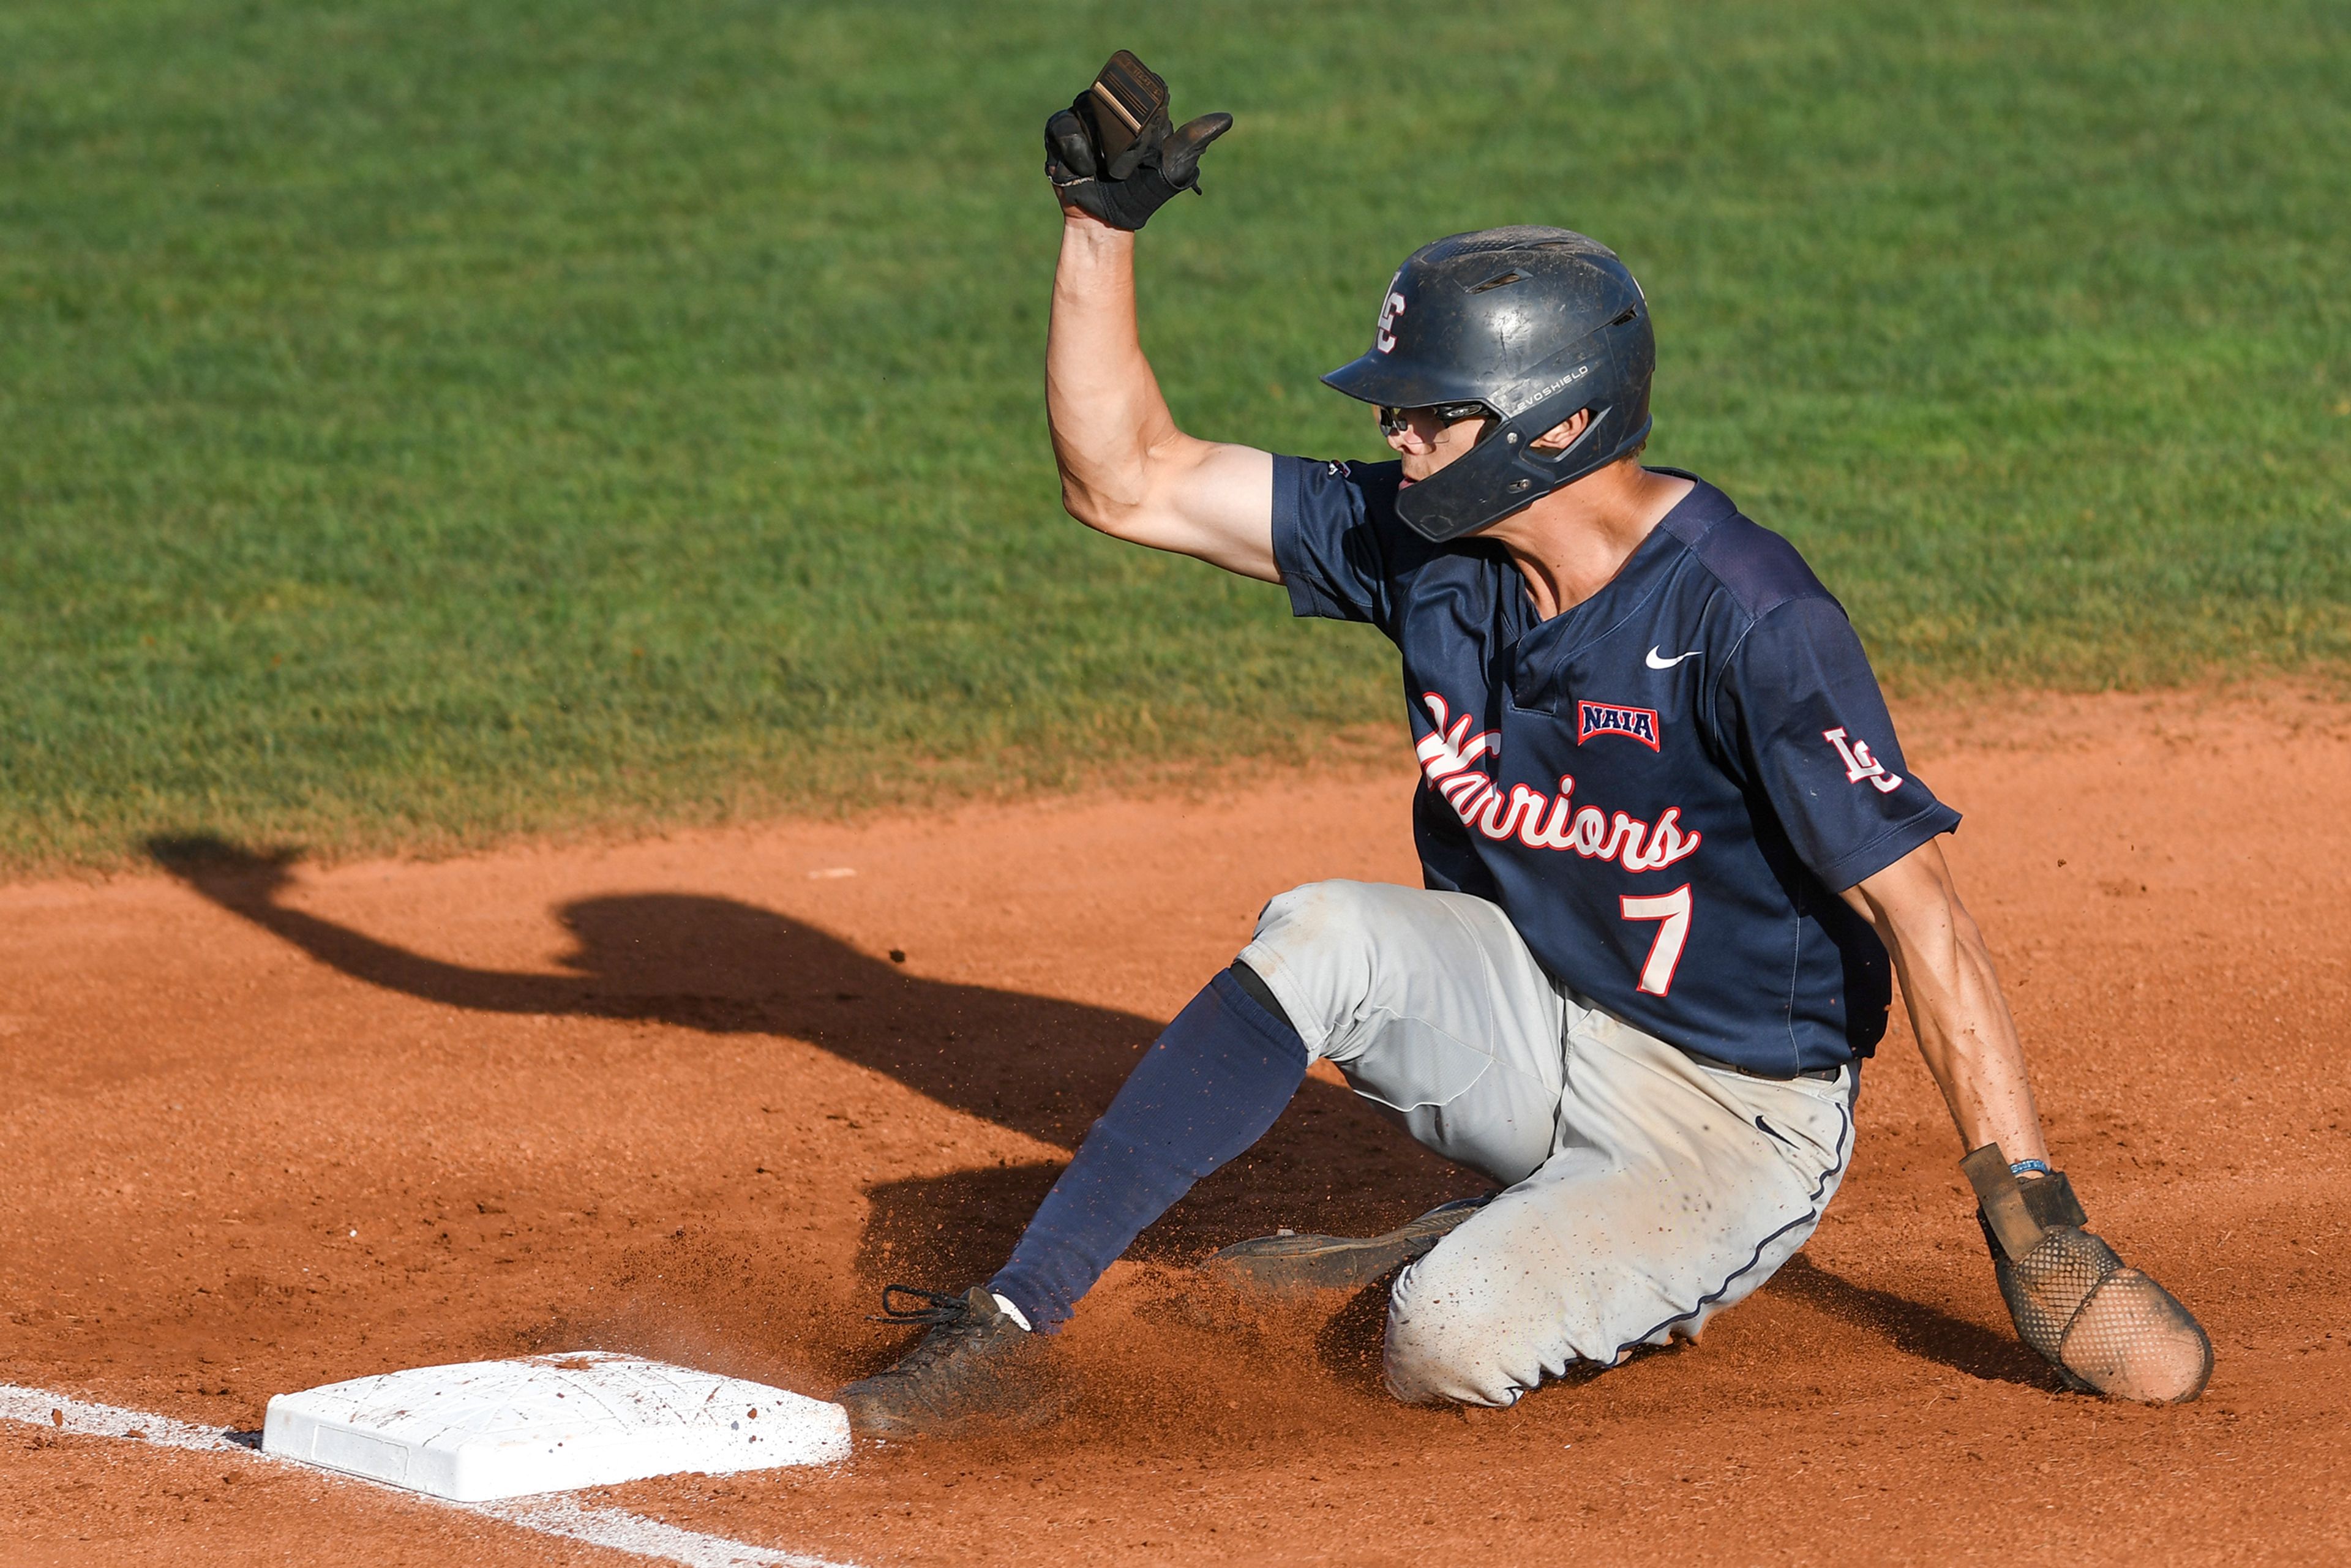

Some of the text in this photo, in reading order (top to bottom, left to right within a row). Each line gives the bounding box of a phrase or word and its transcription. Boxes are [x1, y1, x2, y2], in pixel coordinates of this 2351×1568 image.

[1416, 691, 1702, 873] Warriors
[1582, 705, 1656, 745] NAIA
[1619, 883, 1693, 997] 7
